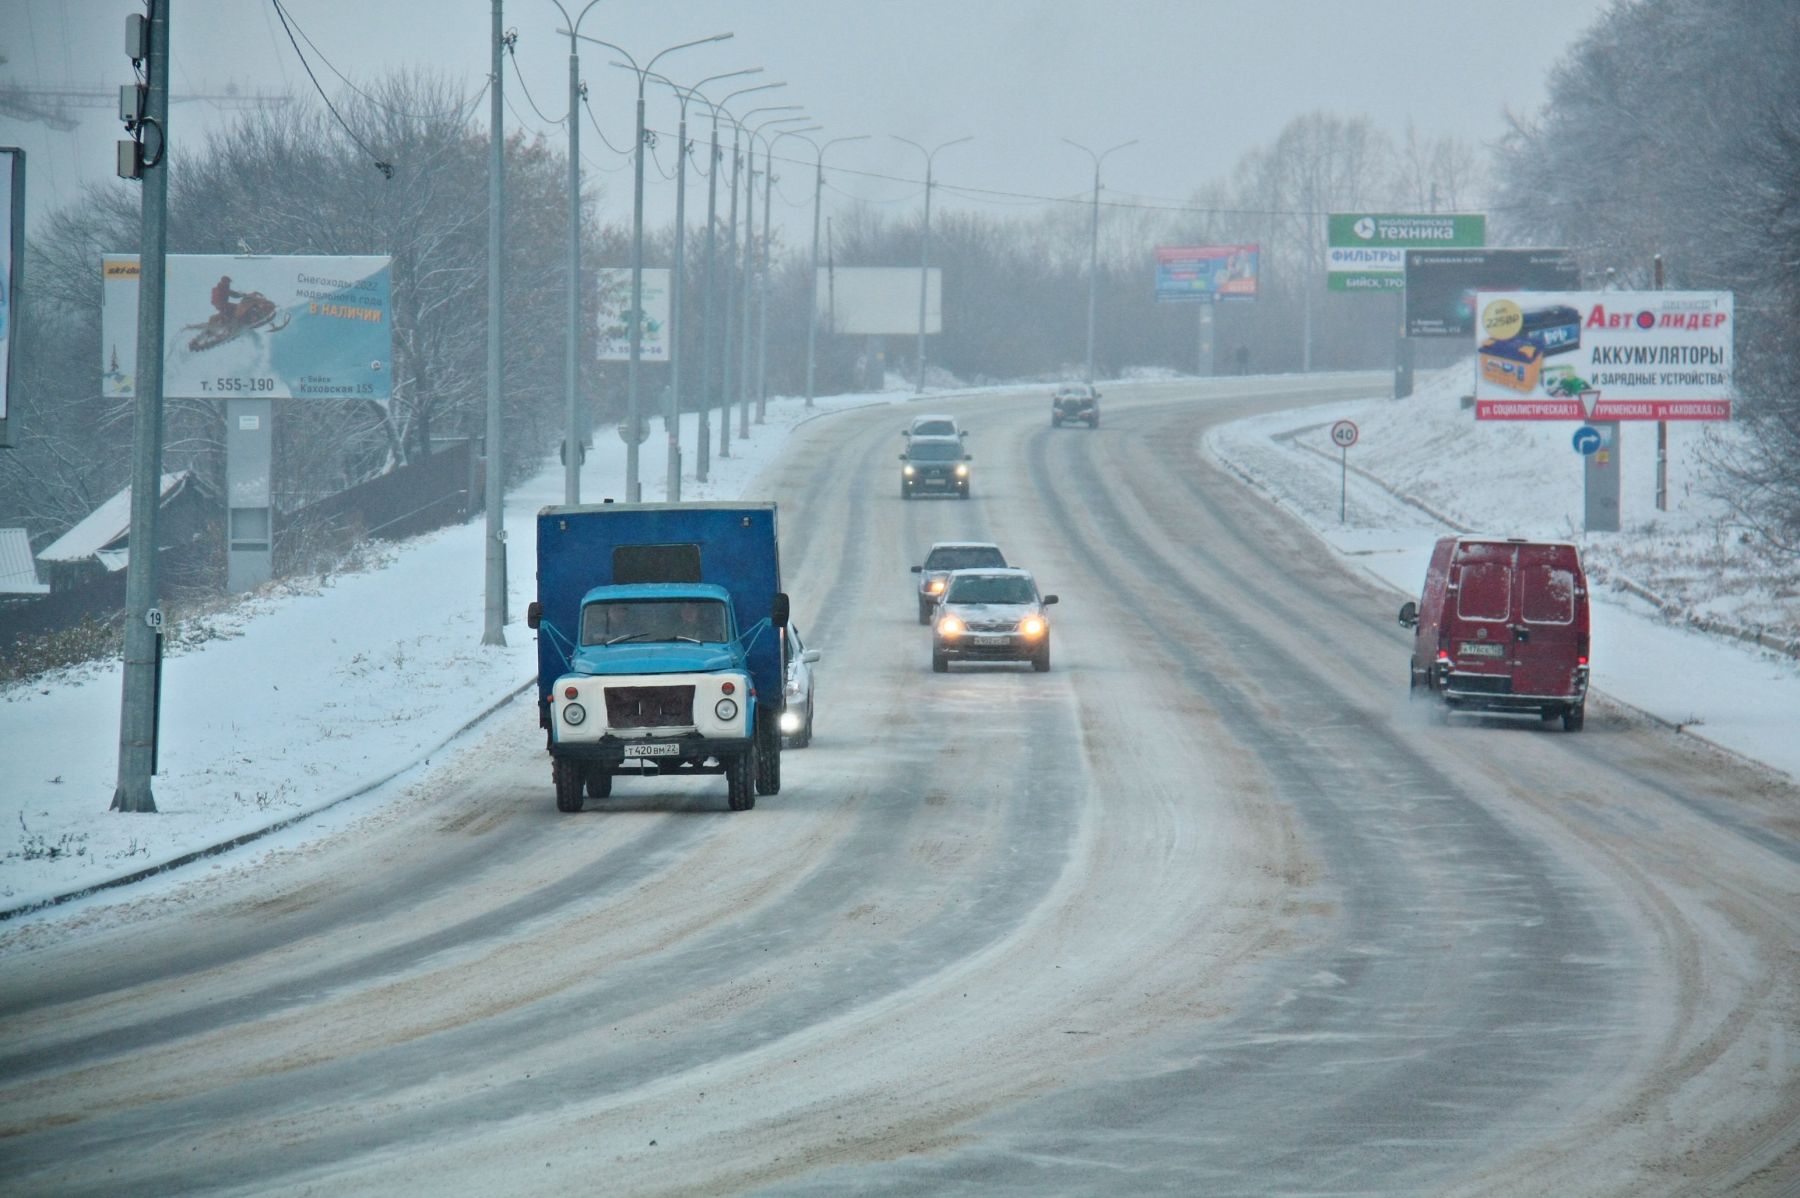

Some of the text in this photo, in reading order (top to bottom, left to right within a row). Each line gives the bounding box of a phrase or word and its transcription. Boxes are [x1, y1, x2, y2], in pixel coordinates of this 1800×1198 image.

[1379, 226, 1454, 239] техника
[1332, 249, 1401, 262] ФИЛЬТРЫ
[297, 272, 352, 289] Снегоходы
[310, 302, 383, 322] В НАЛИЧИИ
[1592, 346, 1724, 365] АККУМУЛЯТОРЫ
[217, 377, 275, 392] 555-190
[1592, 371, 1724, 386] И ЗАРЯДНЫЕ УСТРОЙСТВА
[300, 384, 374, 393] Каховская 155
[1336, 429, 1354, 441] 40
[150, 612, 161, 625] 19
